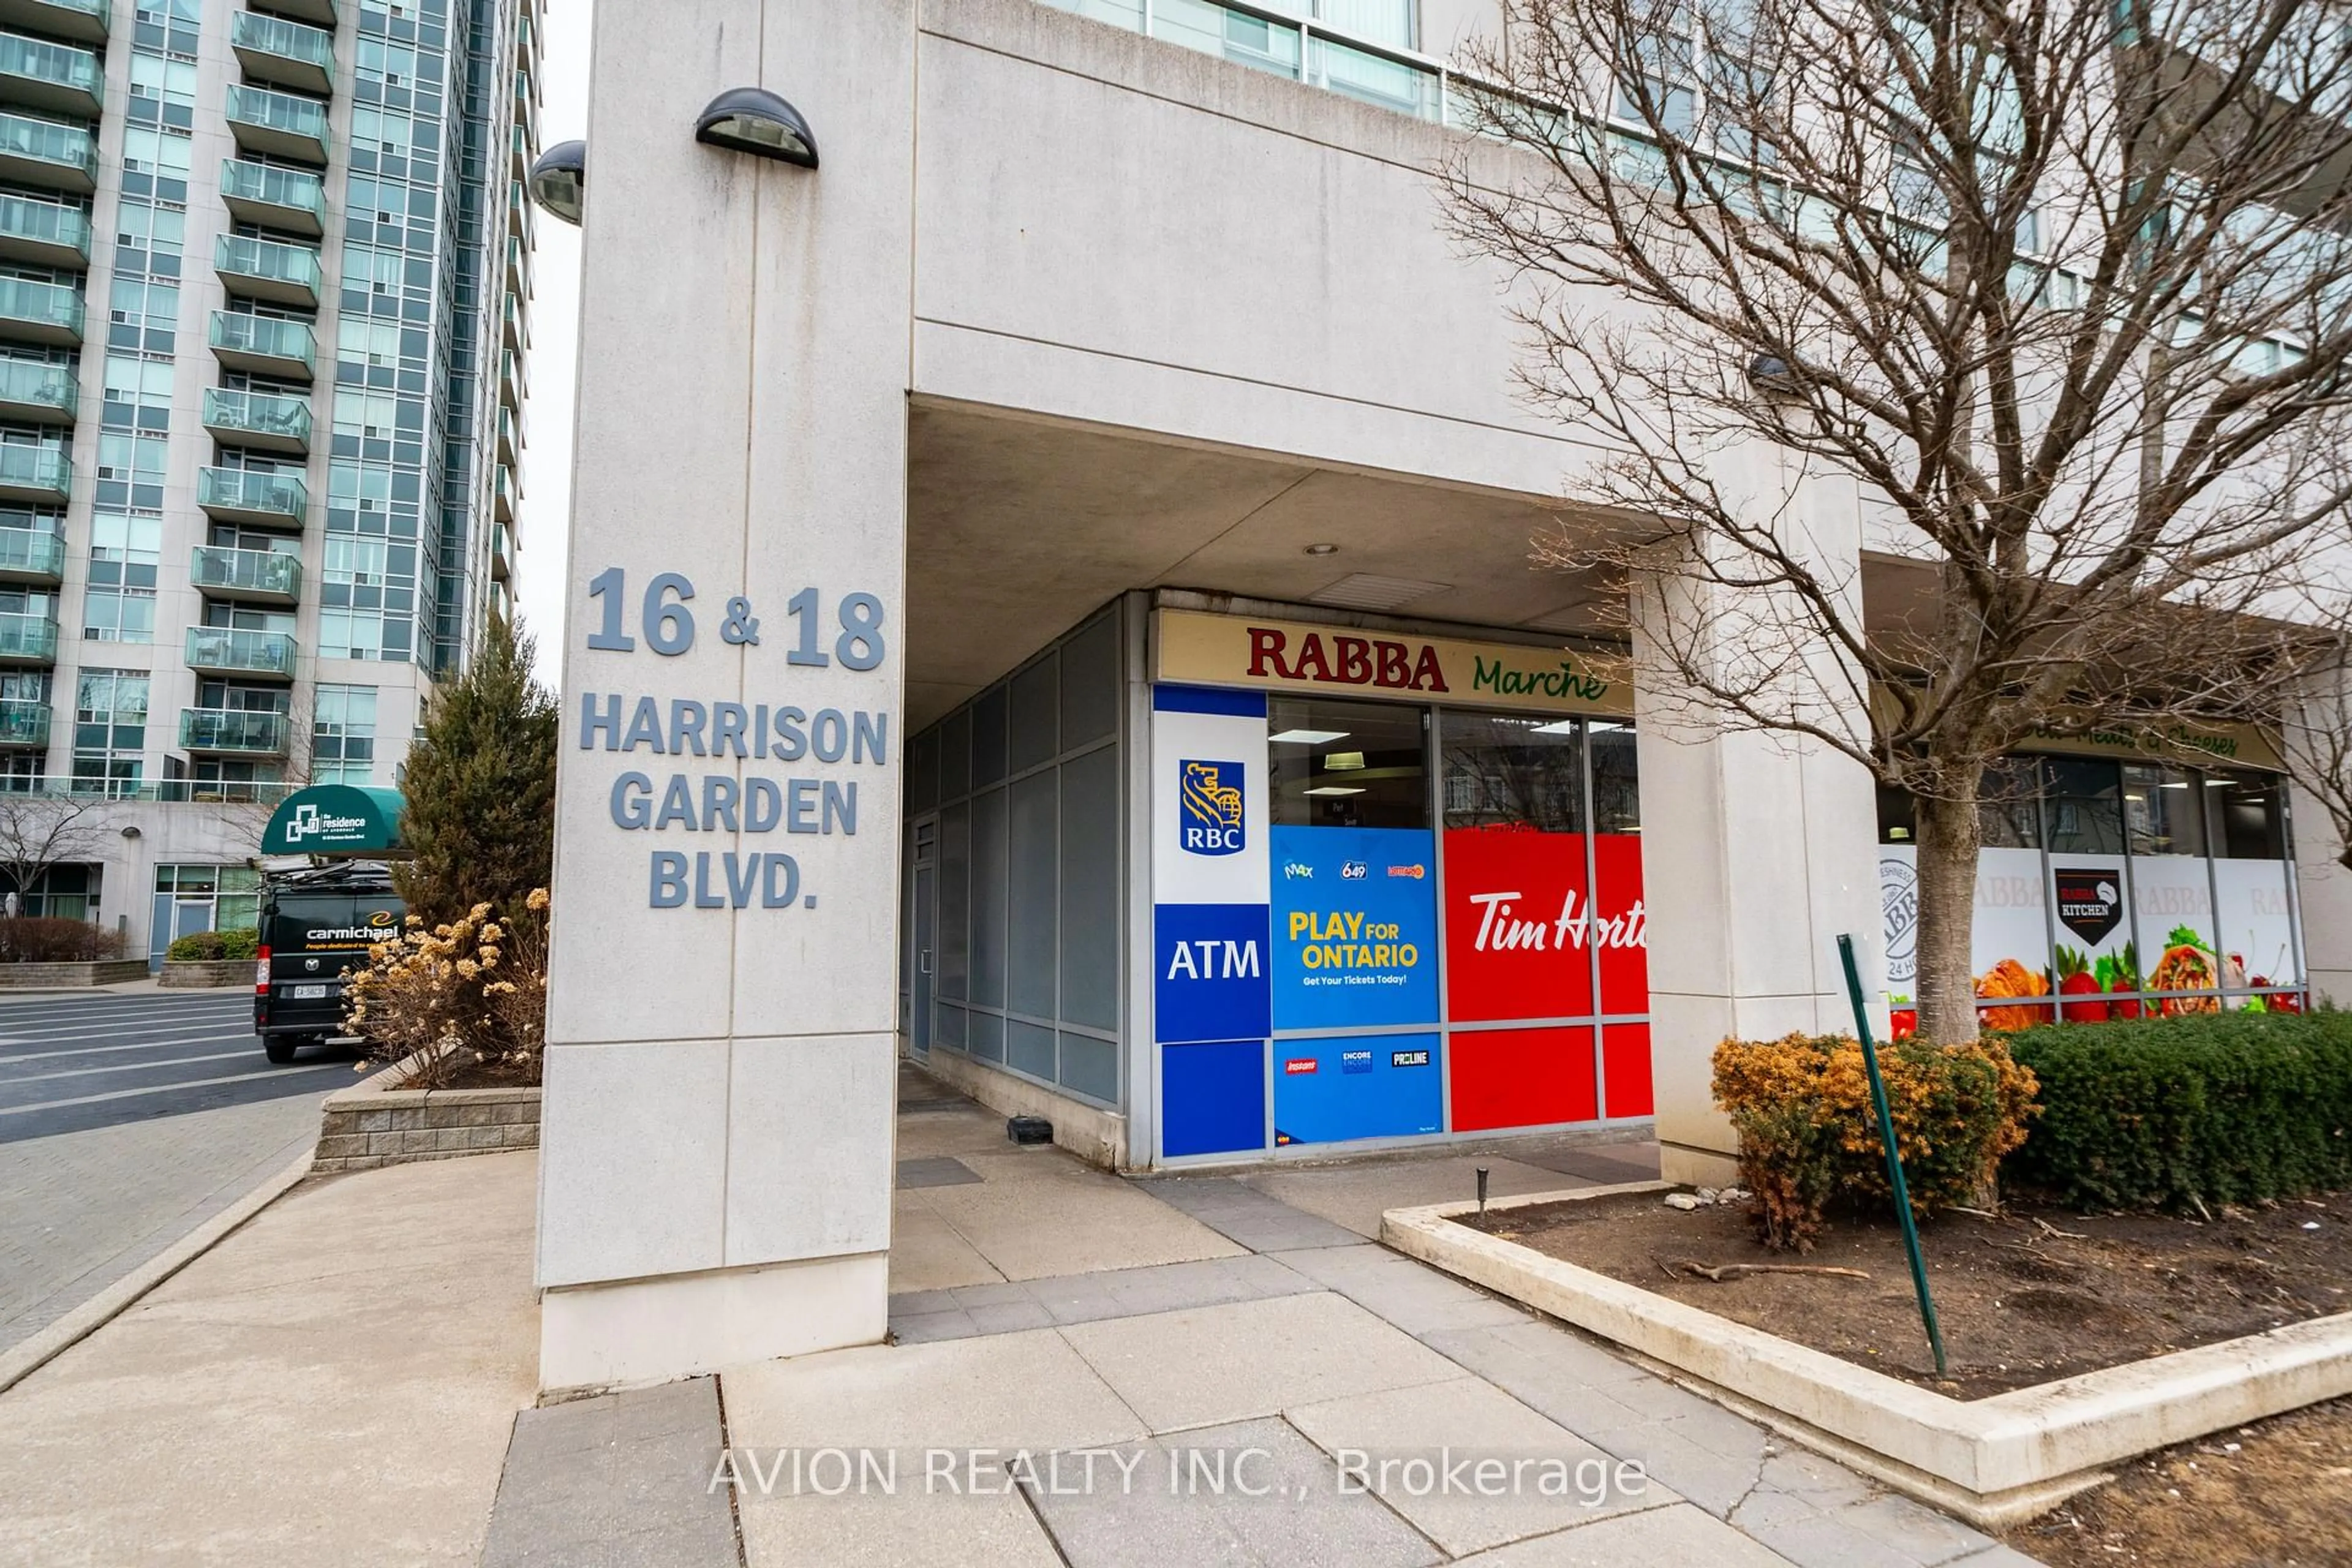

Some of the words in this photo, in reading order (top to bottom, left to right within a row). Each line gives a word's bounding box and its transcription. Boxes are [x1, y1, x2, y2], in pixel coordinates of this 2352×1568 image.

[587, 567, 695, 656] 16
[720, 596, 760, 646] &
[787, 587, 885, 671] 18
[1247, 627, 1449, 693] RABBA
[580, 693, 887, 766] HARRISON
[610, 771, 858, 835] GARDEN
[323, 816, 366, 827] residence
[1187, 827, 1239, 849] RBC
[649, 851, 817, 910] BLVD.
[1470, 892, 1547, 951] Tim
[2062, 904, 2109, 916] KITCHEN
[307, 925, 398, 939] carmichael
[1289, 911, 1364, 940] PLAY
[1366, 924, 1398, 940] FOR
[1167, 940, 1260, 979] ATM
[1302, 944, 1418, 969] ONTARIO
[1890, 962, 1902, 975] 24
[1303, 977, 1319, 986] Get
[1344, 976, 1375, 985] Tickets
[1377, 974, 1406, 986] Today!
[1343, 1051, 1371, 1060] ENCORE
